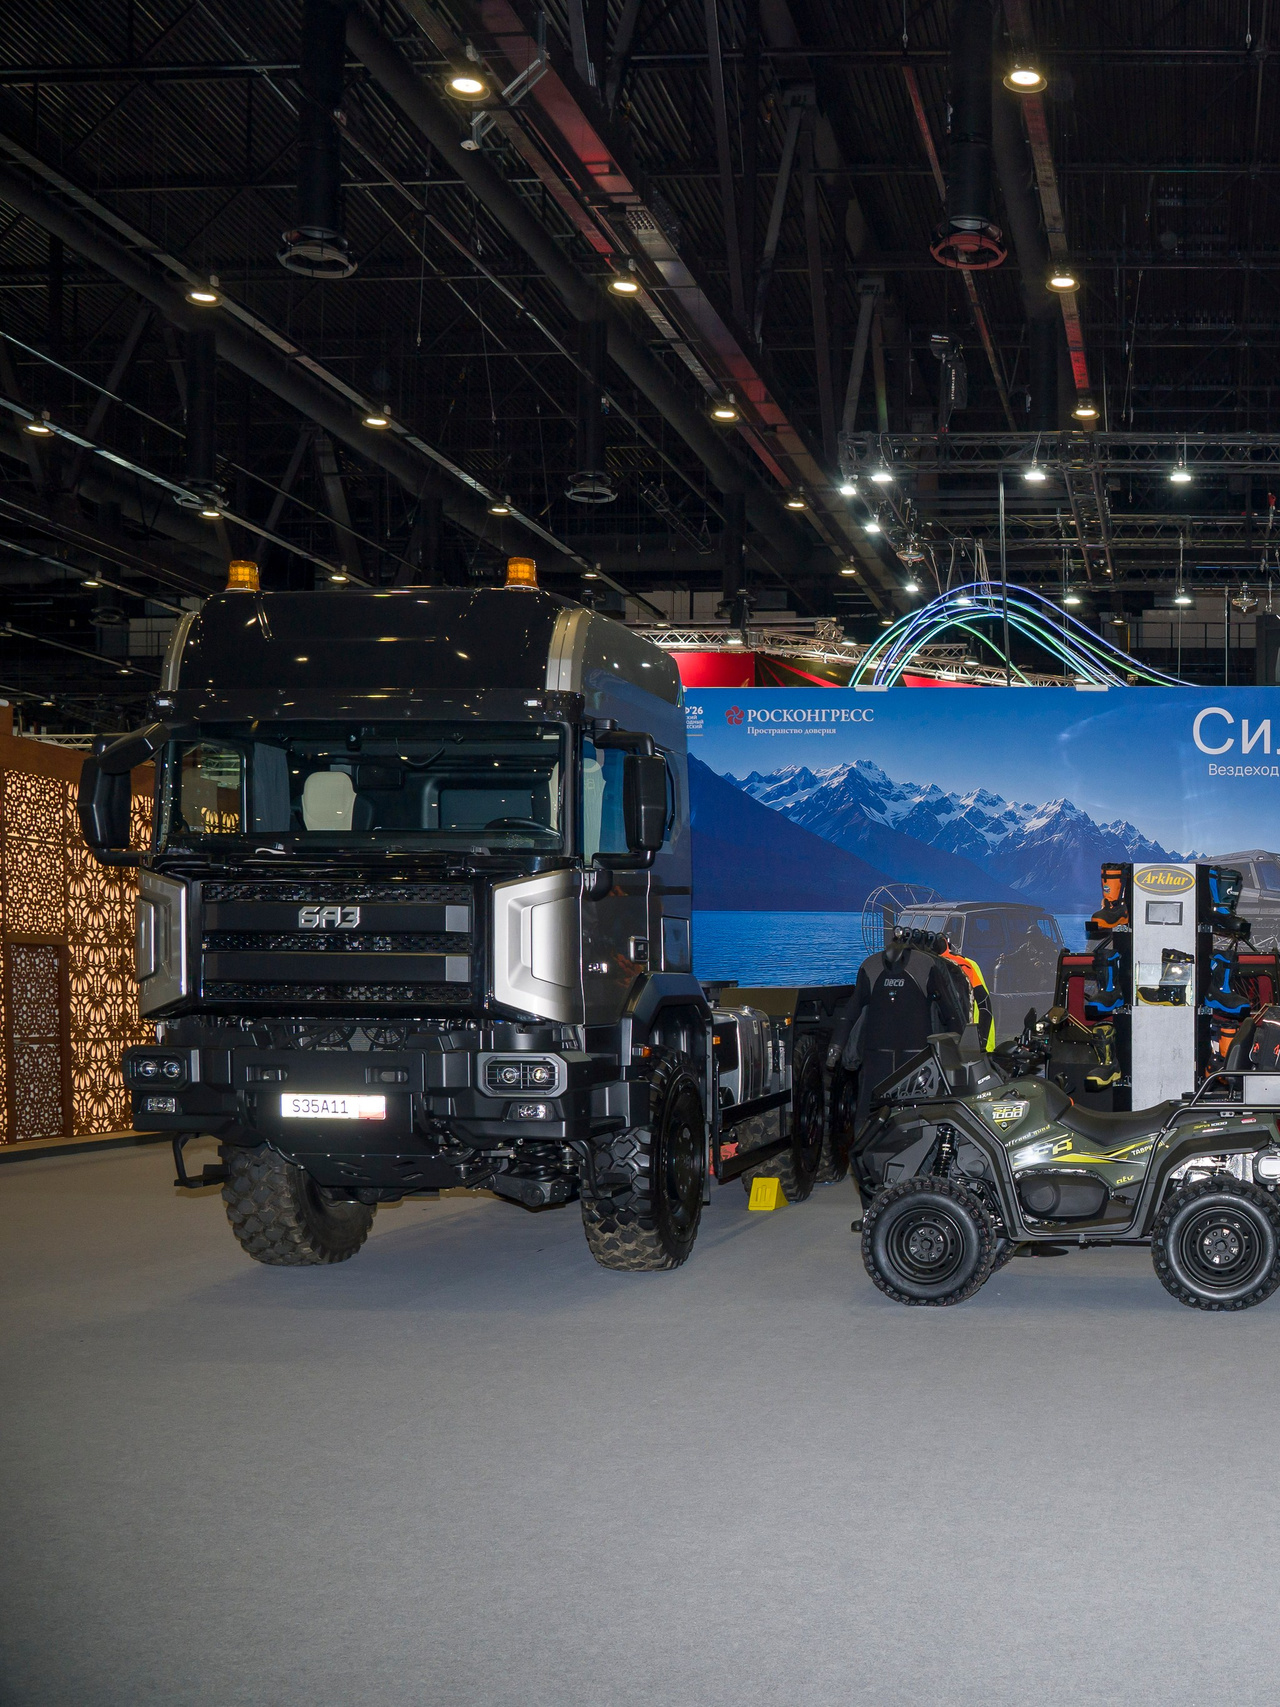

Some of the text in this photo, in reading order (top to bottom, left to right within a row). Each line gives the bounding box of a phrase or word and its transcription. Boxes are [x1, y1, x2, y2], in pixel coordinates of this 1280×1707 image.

[747, 708, 875, 723] РОСКОНГРЕСС
[747, 726, 837, 736] Пространство доверия
[1141, 871, 1189, 886] Arkhar
[298, 906, 361, 928] БАЗ
[292, 1099, 349, 1114] S35A11
[992, 1110, 1022, 1119] 1000
